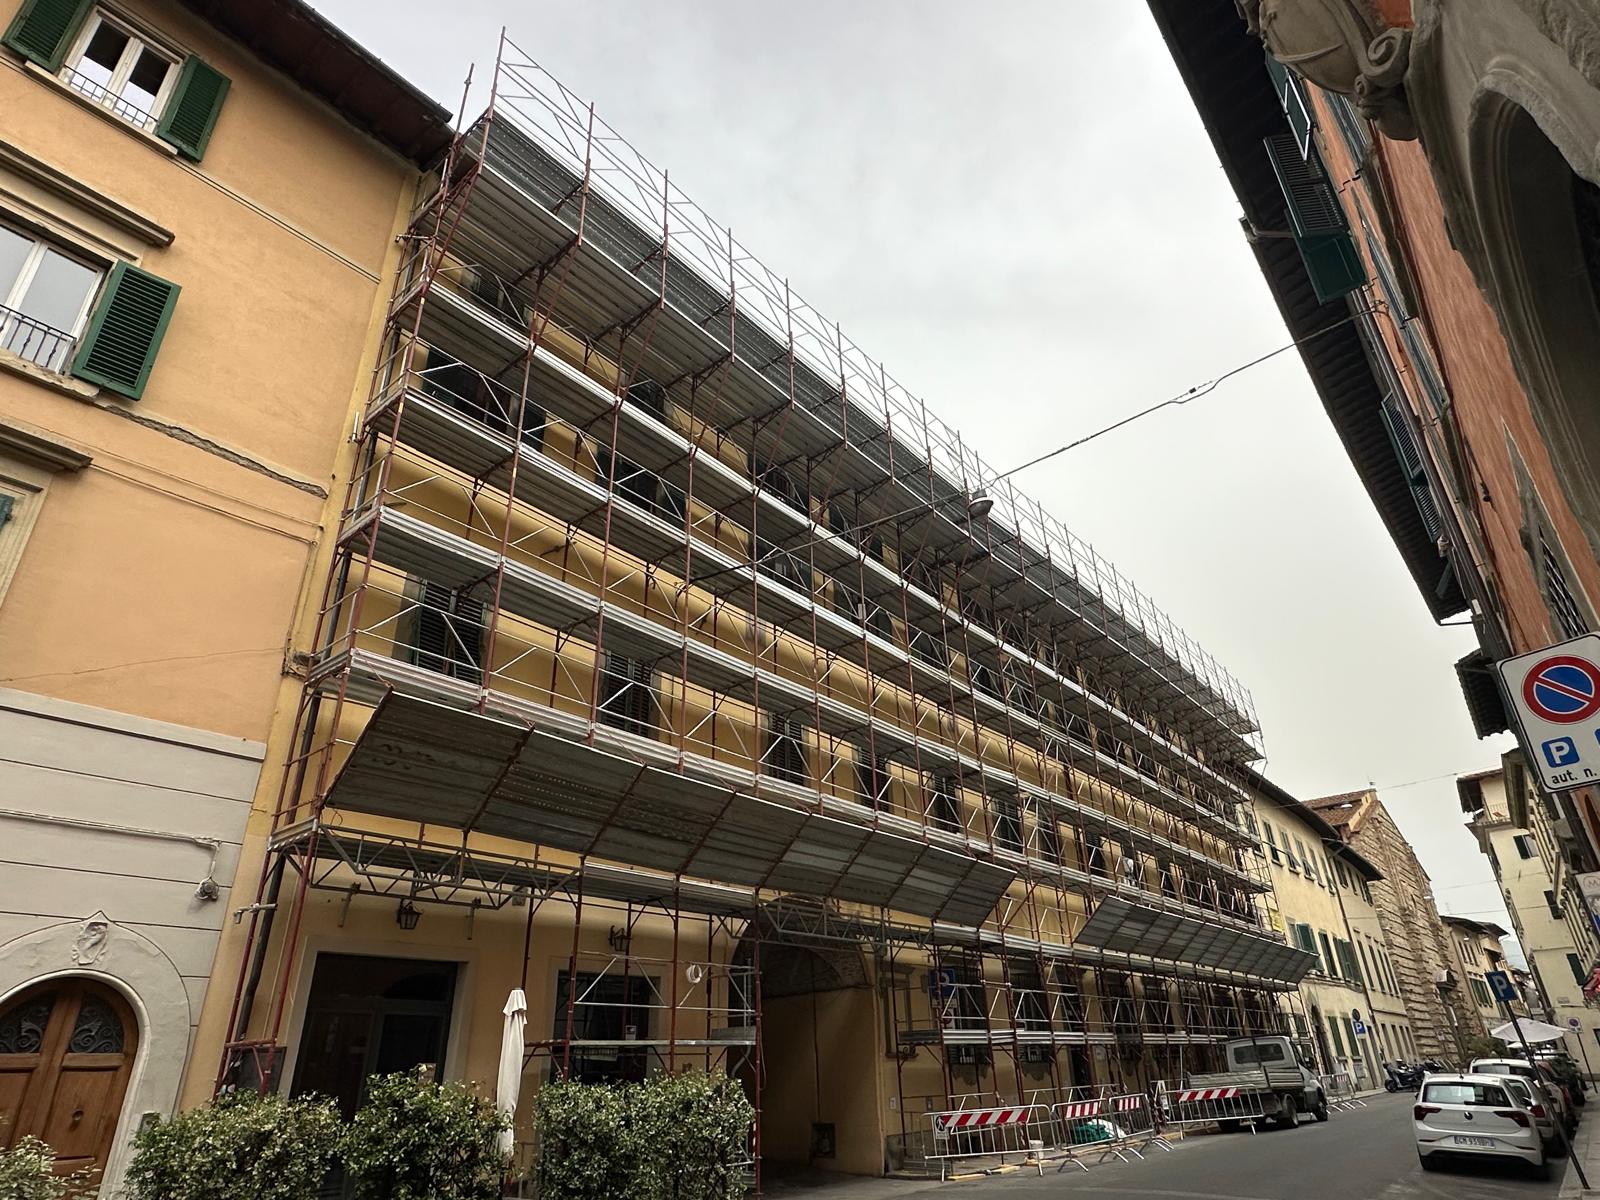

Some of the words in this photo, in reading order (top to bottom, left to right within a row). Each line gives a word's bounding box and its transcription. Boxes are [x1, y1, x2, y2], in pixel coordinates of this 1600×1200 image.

[1549, 741, 1570, 764] P
[1551, 769, 1578, 784] aut.
[1583, 768, 1597, 778] n.
[1491, 975, 1507, 997] P
